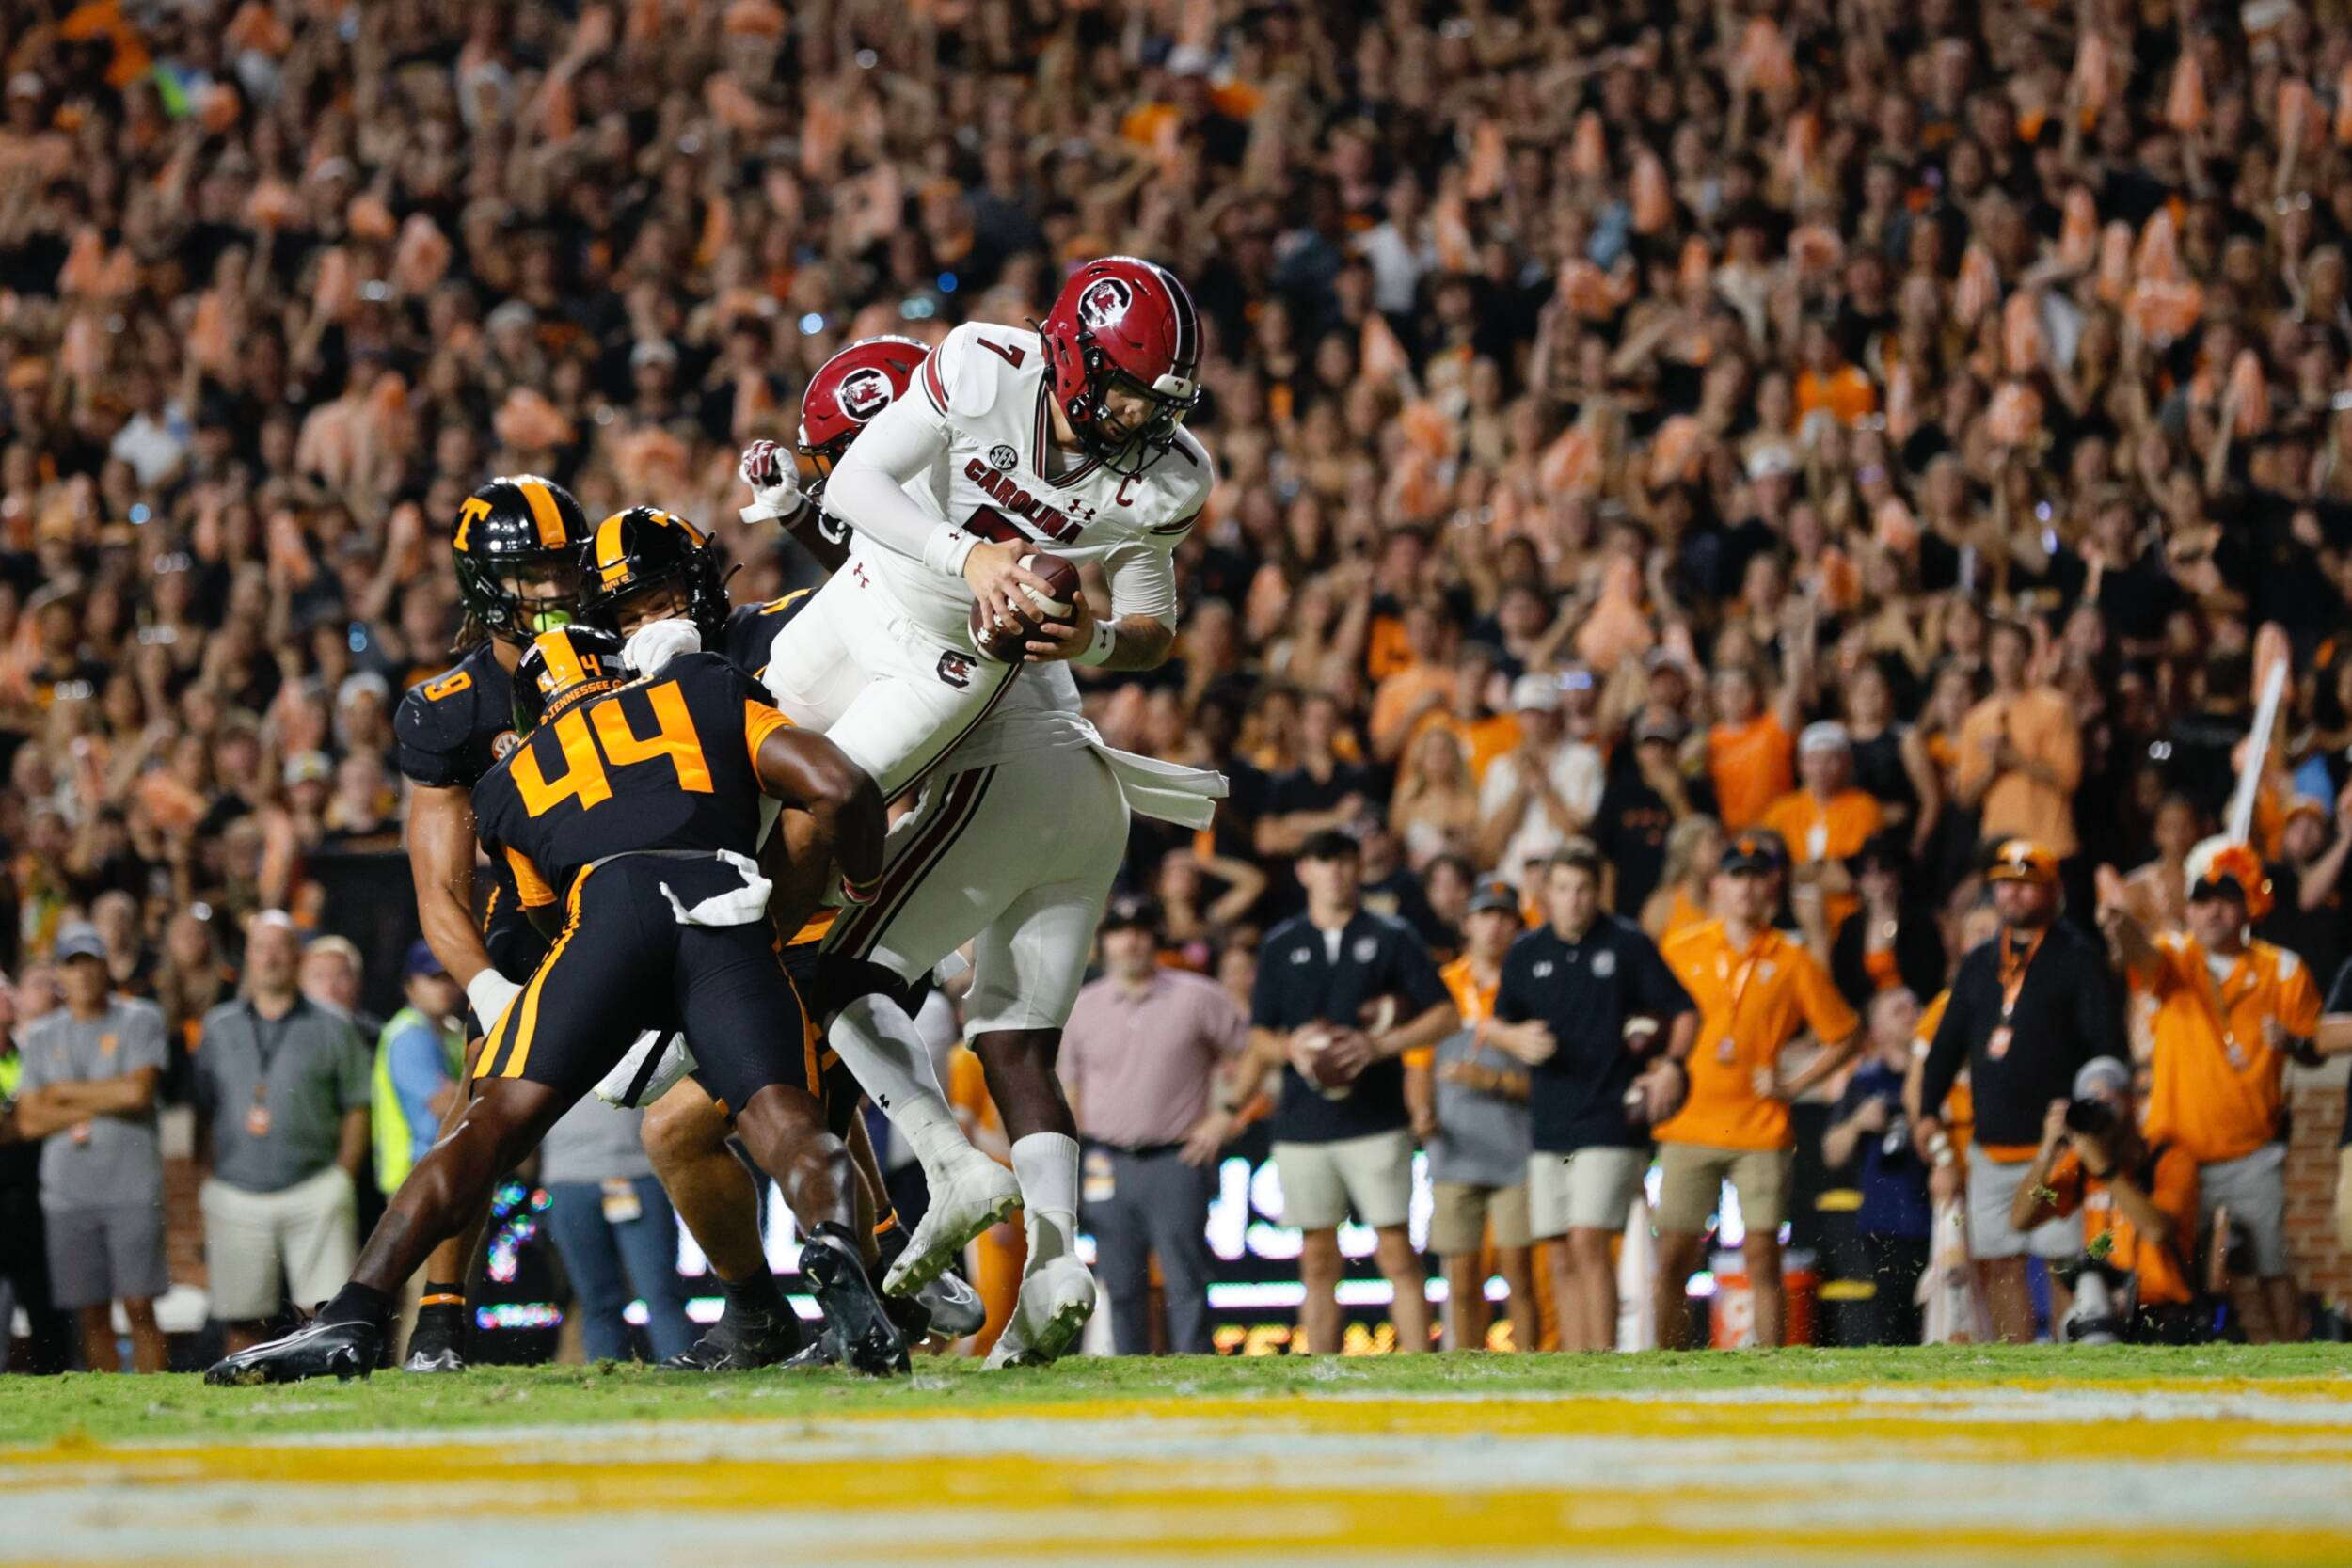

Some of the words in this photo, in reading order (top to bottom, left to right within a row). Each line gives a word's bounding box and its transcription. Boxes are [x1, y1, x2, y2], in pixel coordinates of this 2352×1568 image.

[977, 337, 1025, 370] 7
[990, 445, 1018, 469] SEC
[964, 458, 1084, 546] CAROLINA
[1116, 473, 1142, 507] C
[453, 496, 494, 552] T
[580, 653, 602, 677] 4
[424, 671, 472, 702] 9
[548, 679, 612, 720] TENNESSEE
[509, 679, 714, 818] 44
